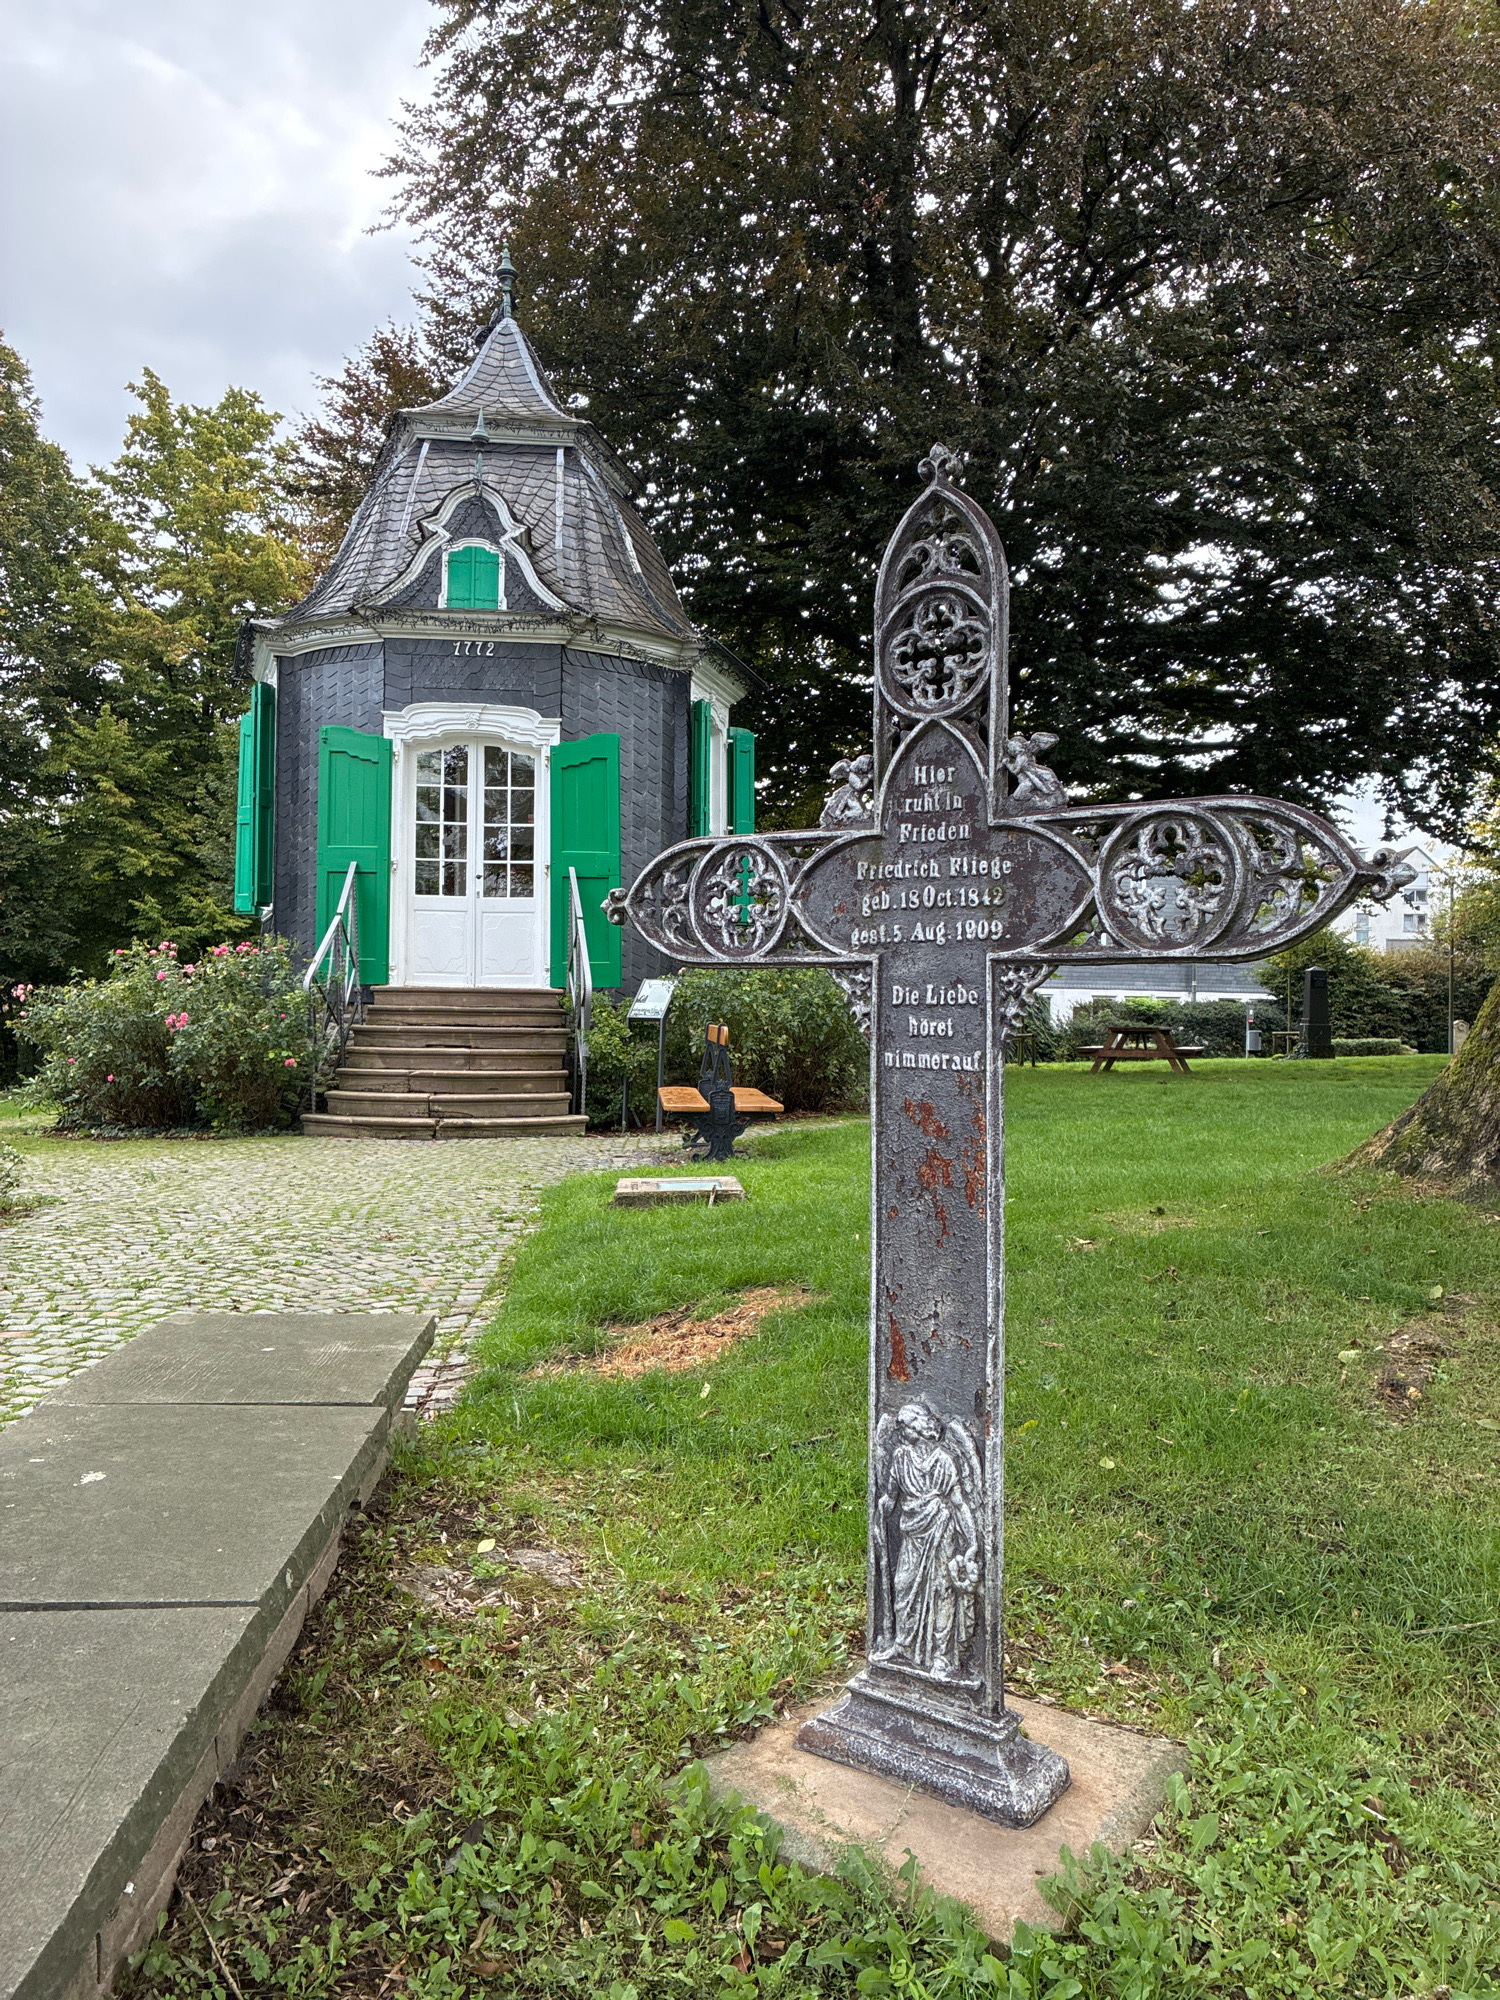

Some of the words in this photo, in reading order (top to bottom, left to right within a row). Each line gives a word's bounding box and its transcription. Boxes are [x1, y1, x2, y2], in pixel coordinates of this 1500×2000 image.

[453, 641, 495, 657] 1772
[914, 765, 956, 786] Hier
[905, 792, 940, 813] ruht
[945, 791, 963, 811] in
[899, 822, 971, 844] Frieden
[856, 858, 941, 881] Friedrich
[950, 857, 1013, 880] Fliege
[861, 890, 897, 917] geb.
[959, 887, 1004, 907] 1842
[891, 985, 919, 1006] Die
[925, 984, 979, 1006] Liebe
[908, 1015, 954, 1037] höret
[884, 1049, 950, 1070] nimmer
